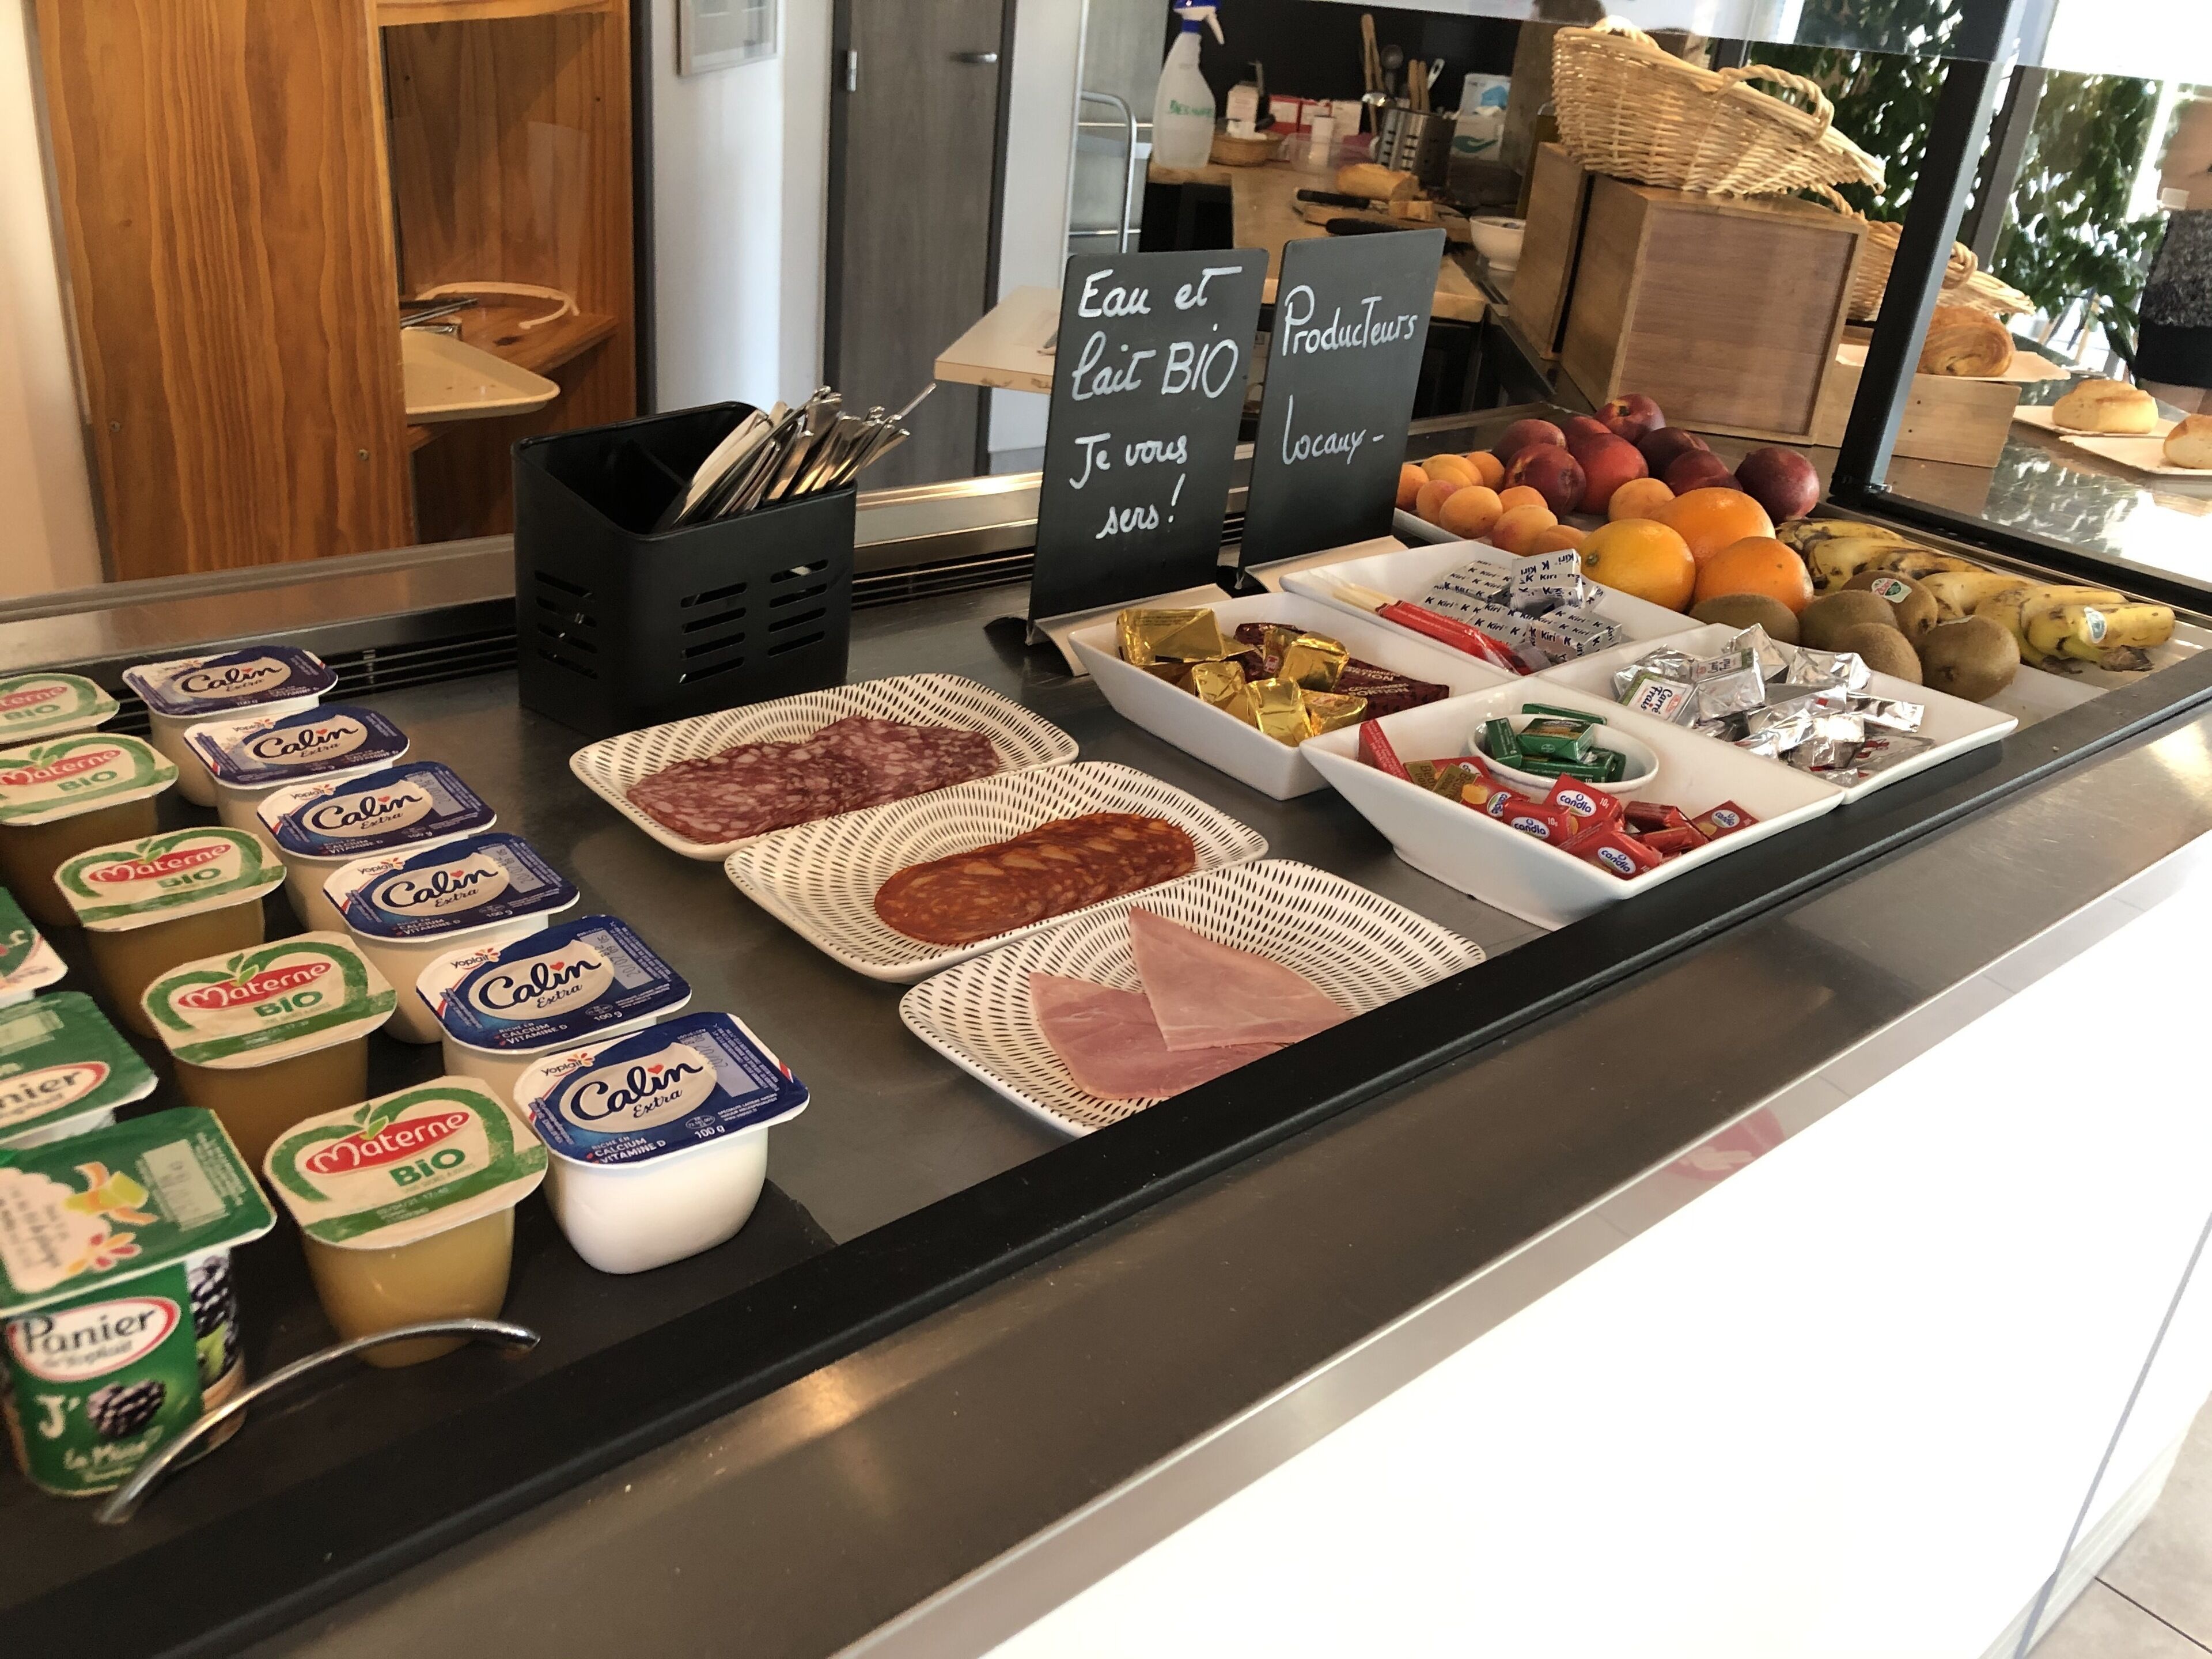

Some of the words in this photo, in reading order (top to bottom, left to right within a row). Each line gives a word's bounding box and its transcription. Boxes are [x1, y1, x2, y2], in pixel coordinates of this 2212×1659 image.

[1078, 269, 1151, 317] Eau
[1071, 331, 1156, 401] lait
[1069, 433, 1111, 490] Je
[1125, 435, 1187, 464] vous
[1425, 596, 1434, 604] K
[1437, 600, 1455, 608] Kiri
[1484, 603, 1502, 612] Kiri
[1474, 618, 1485, 627] K
[1487, 622, 1504, 631] Kiri
[1510, 627, 1521, 635] K
[1568, 615, 1586, 623] Kiri
[1541, 630, 1556, 642] Kiri
[181, 667, 283, 693] Calin
[1641, 686, 1663, 711] Frais
[1652, 688, 1673, 714] Carré
[252, 728, 359, 759] Calin
[0, 751, 117, 785] Materne
[312, 795, 423, 830] Calin
[1560, 794, 1592, 813] candia
[361, 812, 403, 830] Extra
[1514, 822, 1546, 835] candia
[92, 844, 230, 881] Materne
[1601, 850, 1631, 872] candia
[381, 869, 499, 908] Calin
[435, 889, 479, 908] Extra
[184, 963, 329, 1007] Materne
[479, 960, 602, 1009] Calin
[537, 984, 582, 1008] Extra
[594, 1013, 612, 1021] 100
[502, 1024, 550, 1039] CALCIUM
[505, 1026, 559, 1044] VITAMINE
[570, 1063, 703, 1120] Calin
[633, 1089, 683, 1118] Extra
[313, 1113, 464, 1172] Materne
[695, 1127, 715, 1138] 100
[716, 1125, 725, 1134] g
[594, 1137, 647, 1157] CALCIUM
[600, 1143, 657, 1163] VITAMINE
[20, 1308, 156, 1354] Panier
